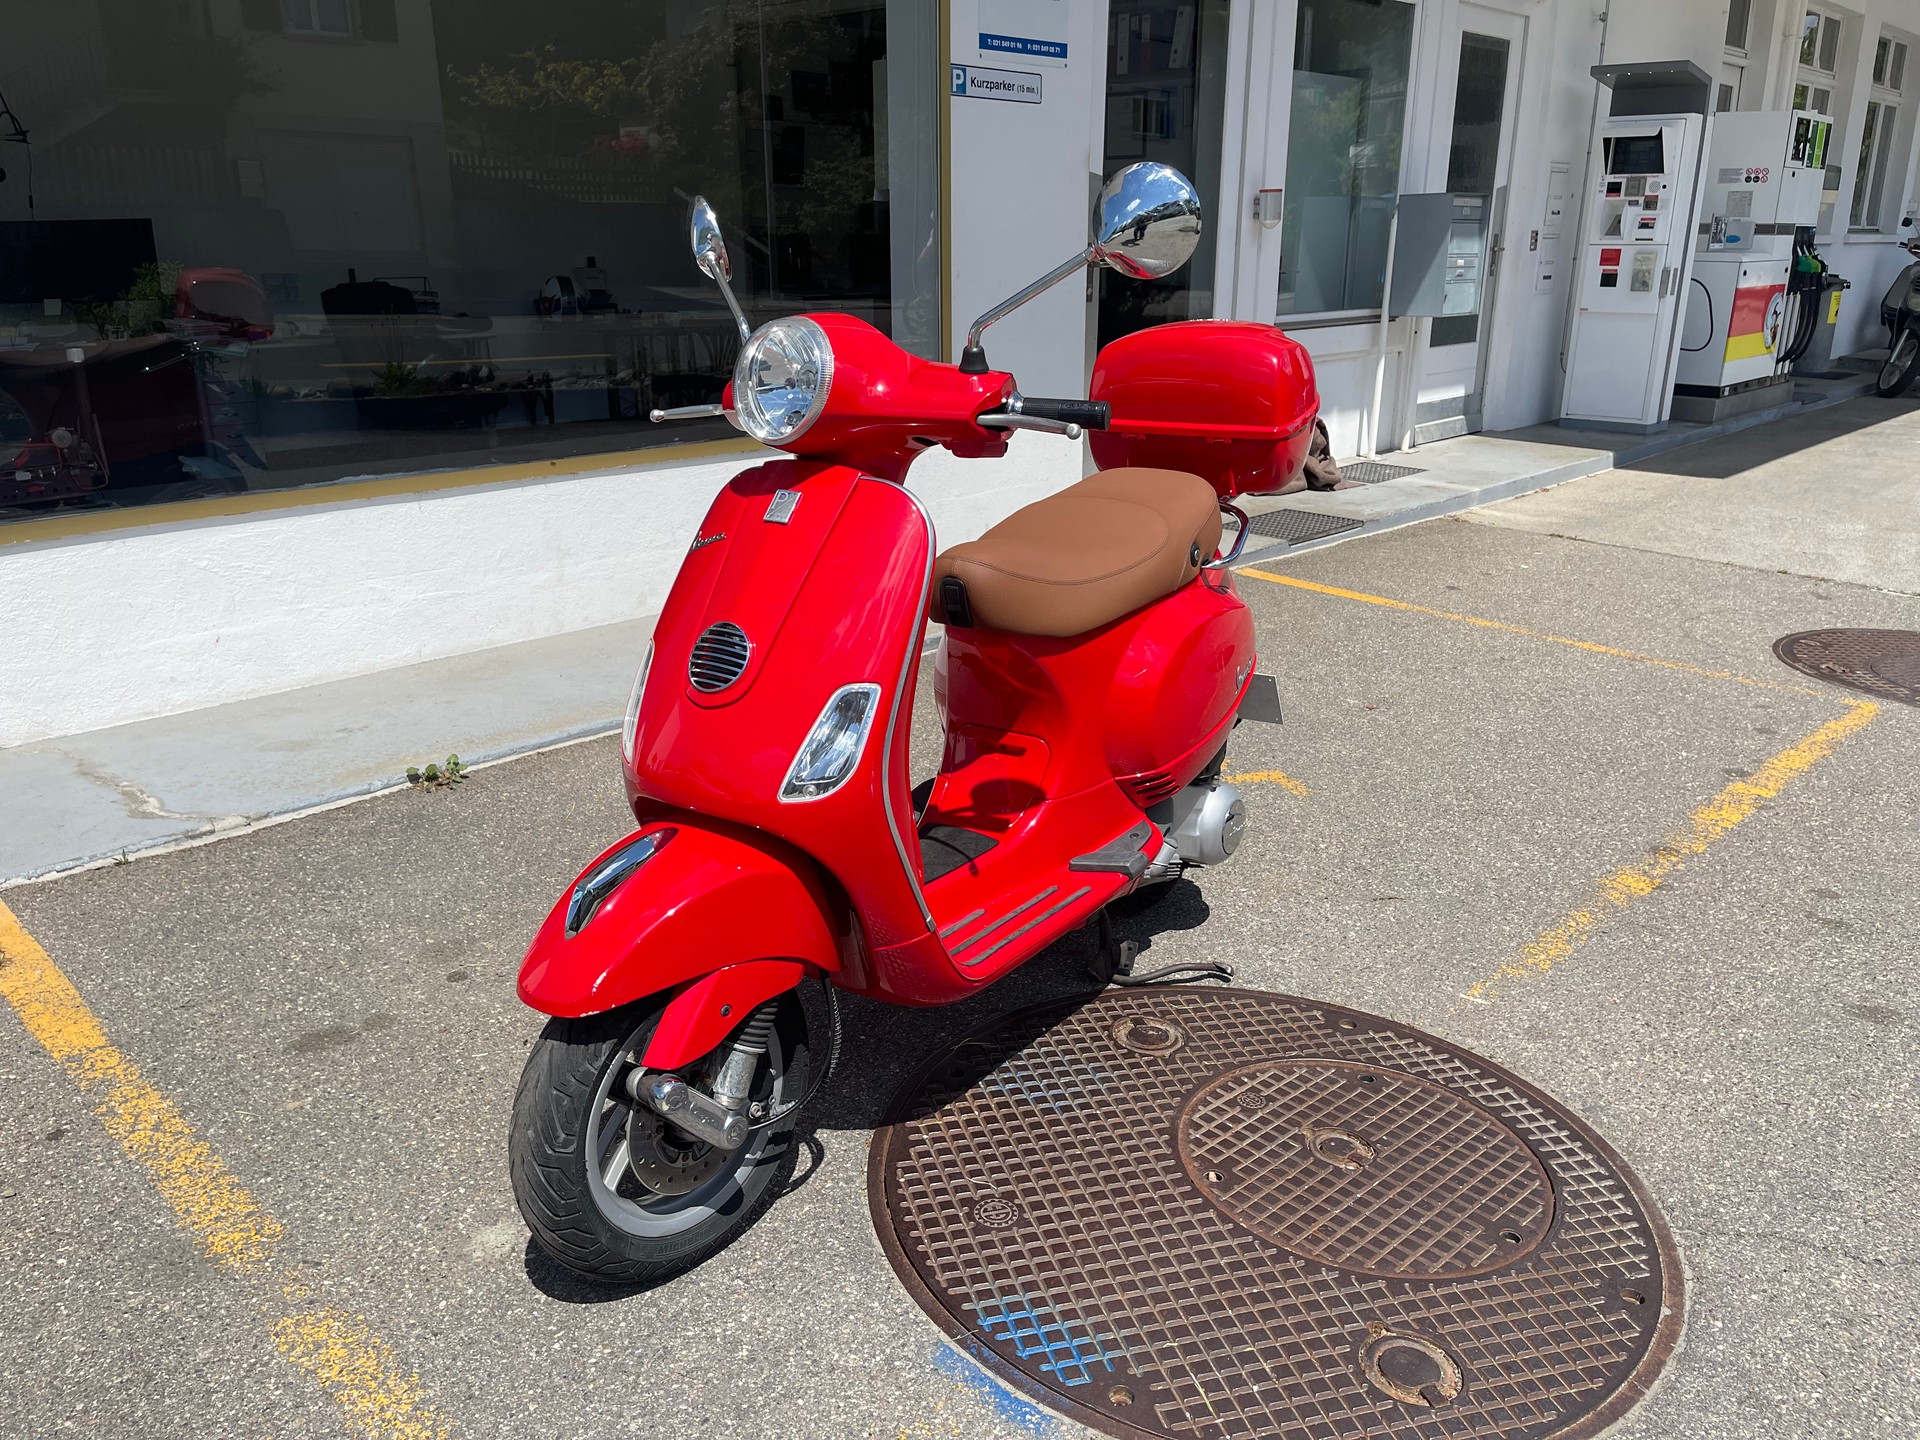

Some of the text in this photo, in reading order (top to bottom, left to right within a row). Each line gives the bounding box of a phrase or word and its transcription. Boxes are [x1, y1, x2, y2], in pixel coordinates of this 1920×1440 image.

[952, 69, 1039, 95] P Kurzparker (15 min.)
